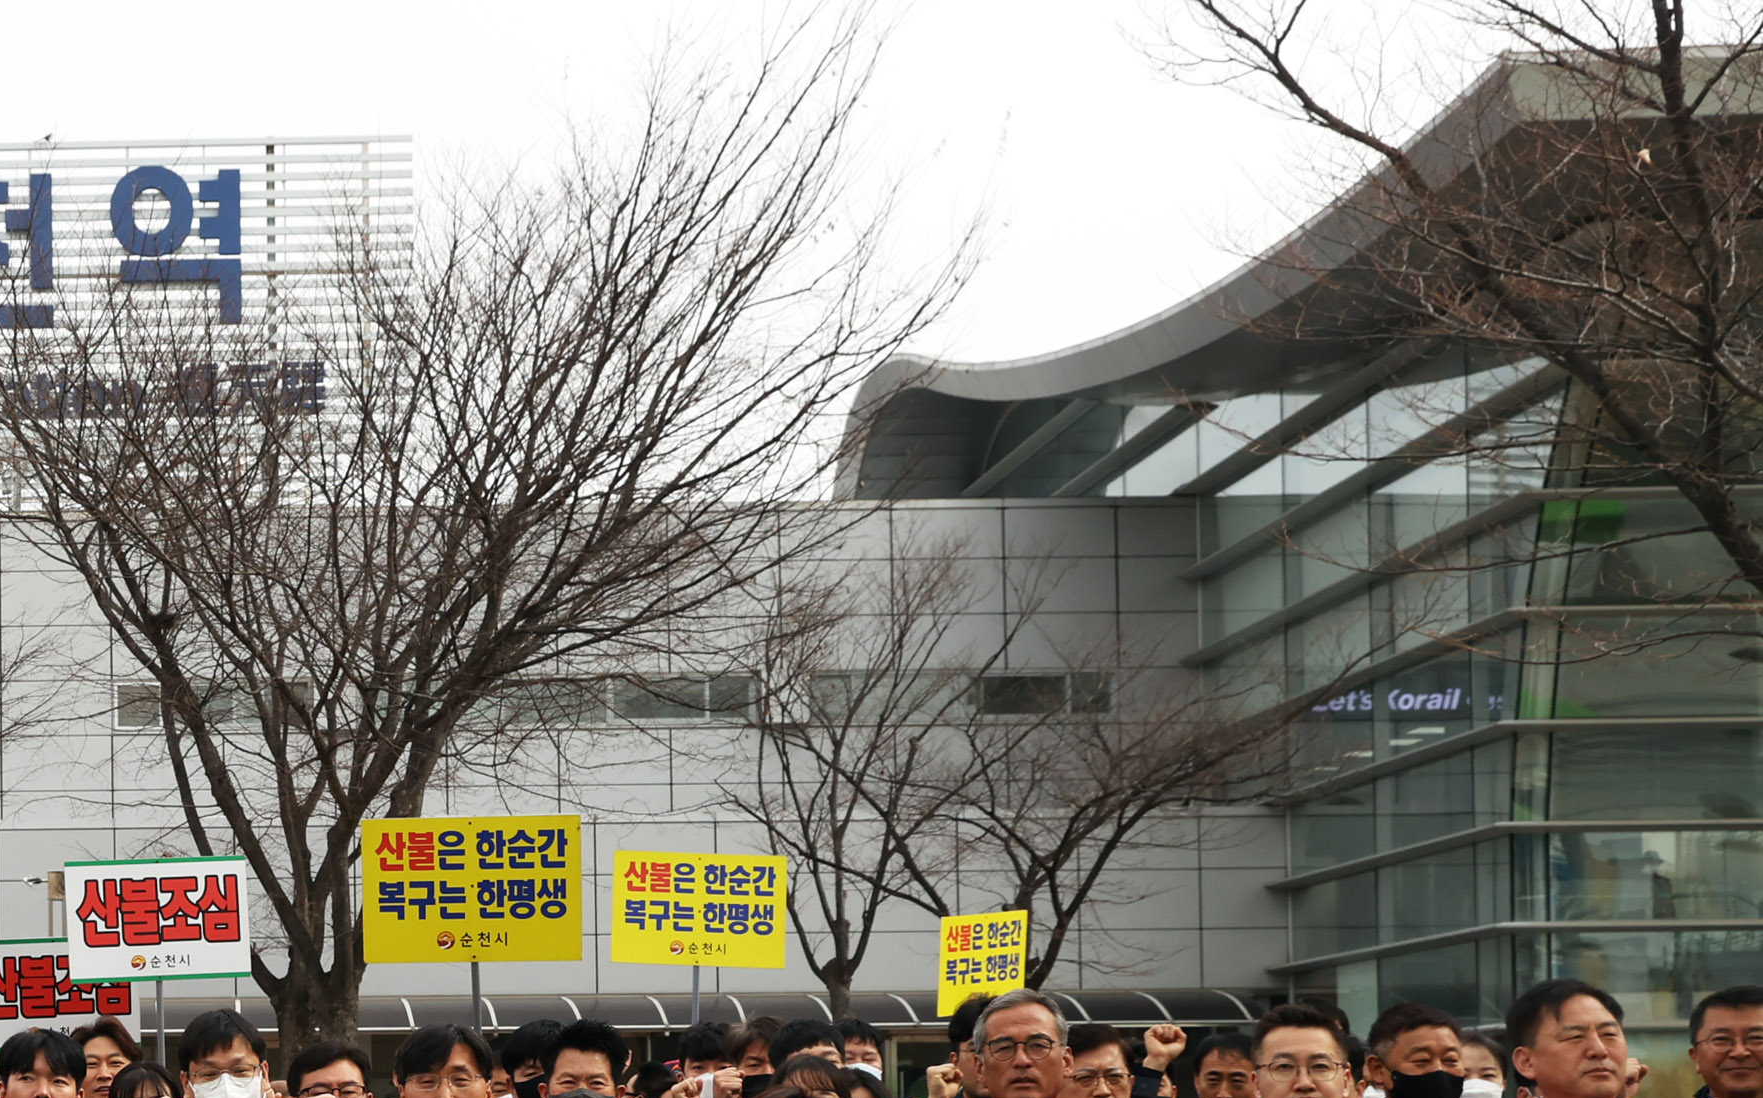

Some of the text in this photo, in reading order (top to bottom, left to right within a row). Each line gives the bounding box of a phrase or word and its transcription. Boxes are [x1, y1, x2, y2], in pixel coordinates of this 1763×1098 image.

[374, 827, 569, 873] 산불은 한순간
[624, 860, 777, 897] 산불은 한순간
[76, 873, 242, 949] 산불조심
[377, 877, 568, 922] 복구는 한평생
[624, 899, 775, 937] 복구는 한평생
[459, 930, 509, 948] 순천시
[687, 941, 728, 957] 순천시
[945, 921, 1022, 953] 산불은 한순간
[149, 952, 191, 969] 순천시
[945, 952, 1020, 986] 복구는 한평생
